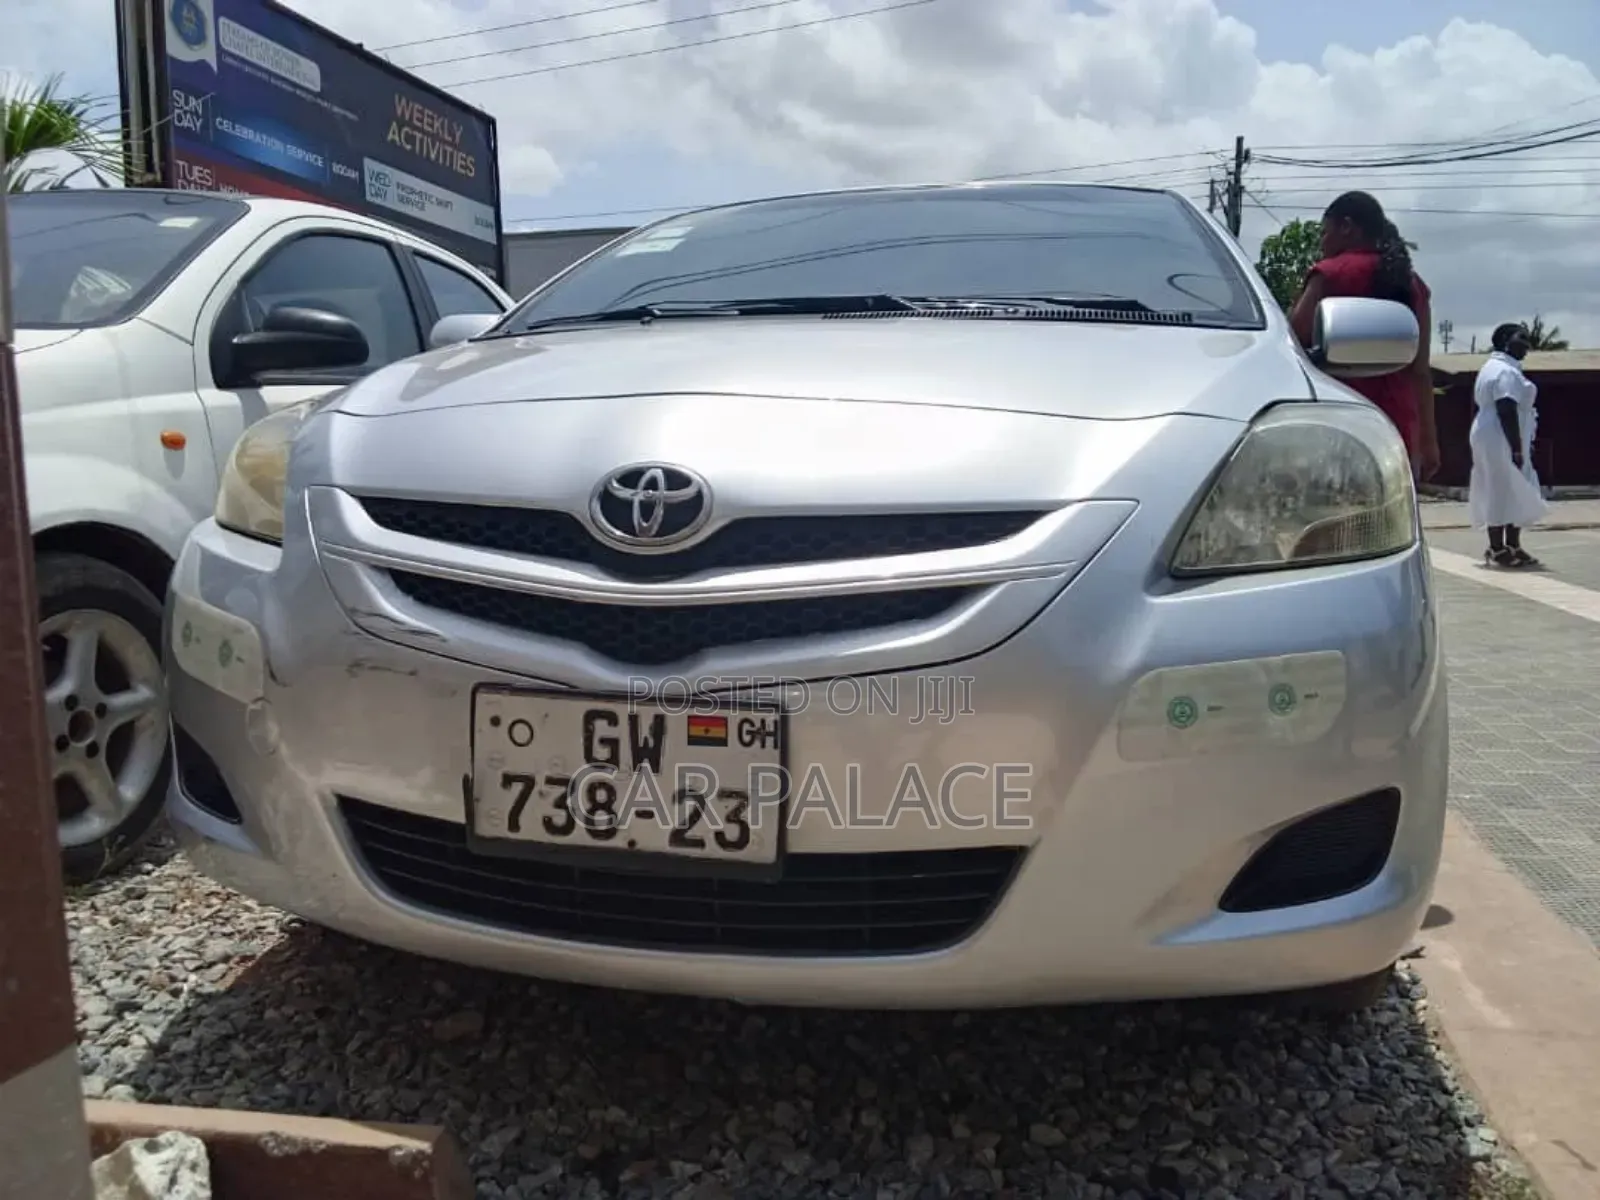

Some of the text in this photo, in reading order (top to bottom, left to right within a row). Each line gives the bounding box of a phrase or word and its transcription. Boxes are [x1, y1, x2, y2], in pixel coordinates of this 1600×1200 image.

[172, 89, 203, 116] SUN
[173, 108, 203, 135] DAY
[215, 117, 285, 154] CELEBRATION
[394, 93, 463, 148] WEEKLY
[387, 121, 475, 178] ACTIVITIES
[175, 159, 213, 187] TUES
[366, 167, 392, 188] WED
[368, 184, 388, 201] DAY
[583, 708, 780, 776] GW GH
[501, 772, 751, 853] 738-23
